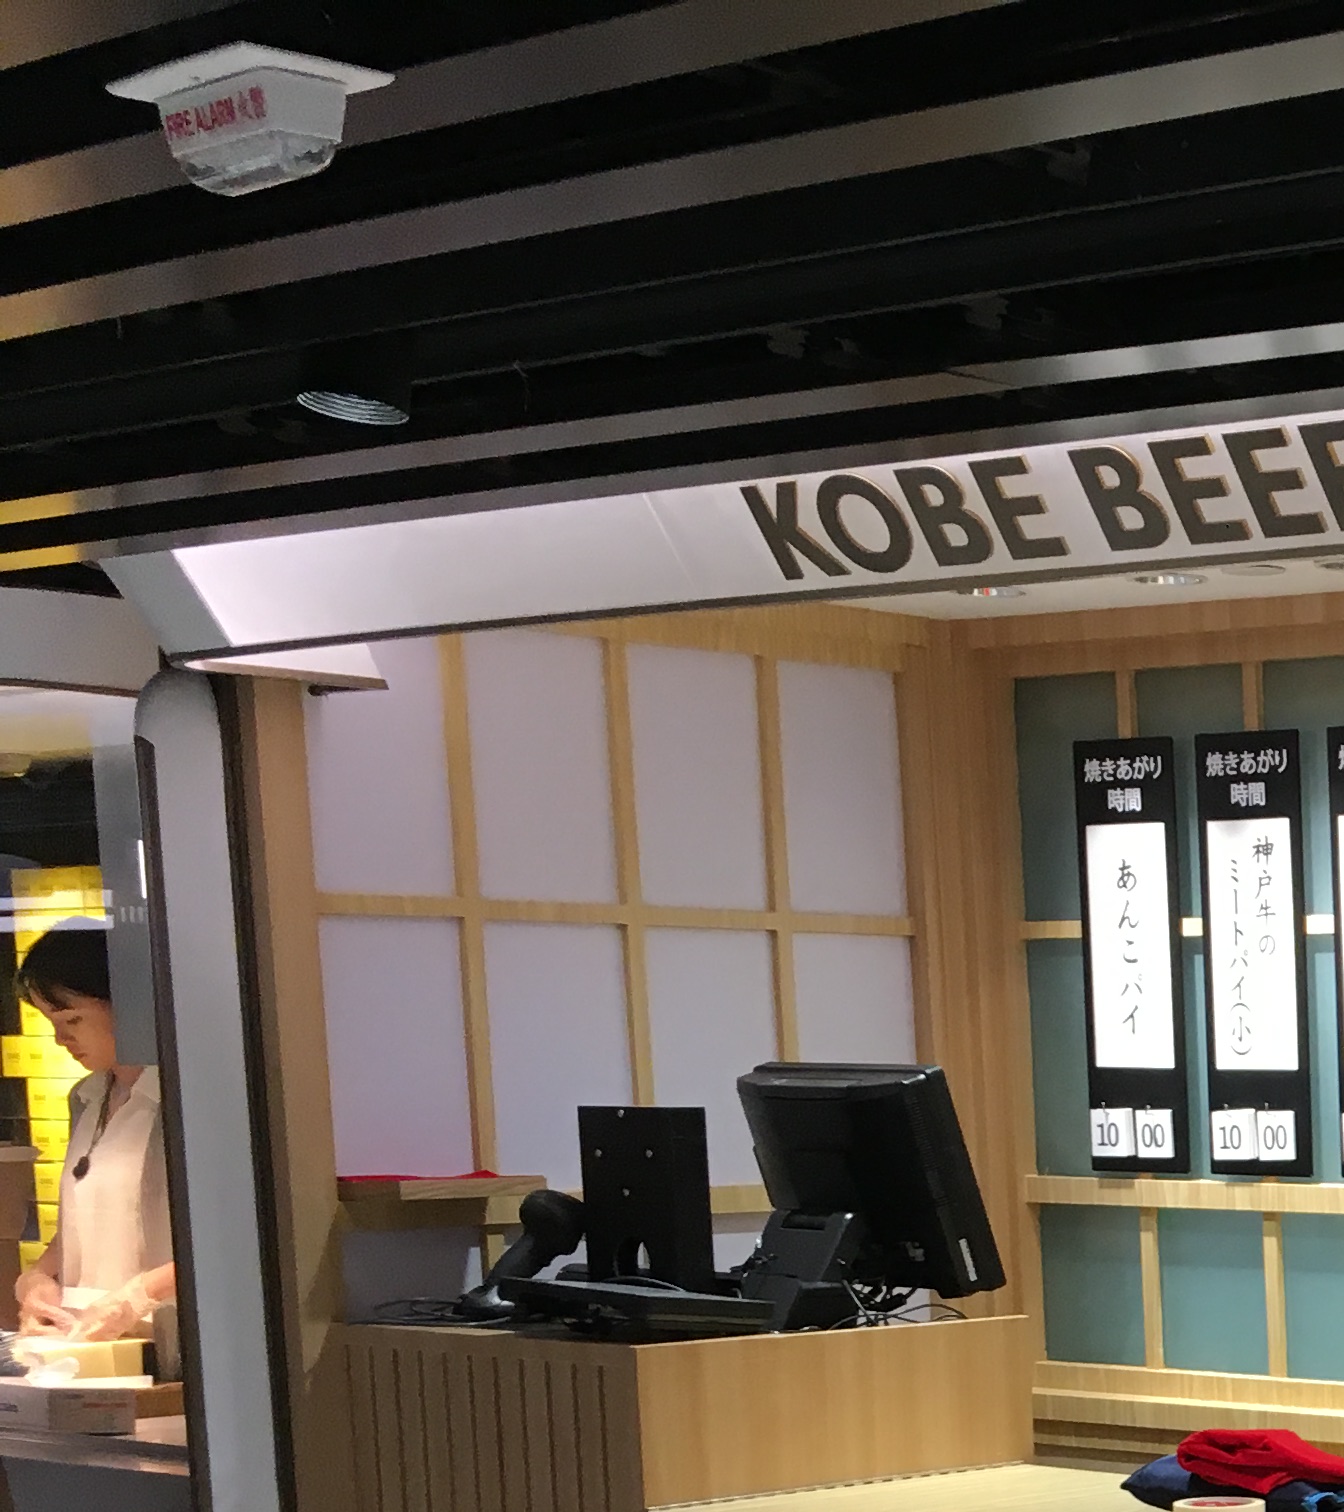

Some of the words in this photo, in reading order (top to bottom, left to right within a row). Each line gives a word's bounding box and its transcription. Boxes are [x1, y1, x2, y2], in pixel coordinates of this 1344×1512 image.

[739, 456, 1071, 580] KOBE
[1084, 755, 1162, 782] 焼きあがり
[1205, 748, 1288, 777] 焼きあがり
[1107, 787, 1142, 813] 時間
[1230, 782, 1265, 806] 時間
[1117, 858, 1143, 1035] あんこパイ
[1097, 1123, 1119, 1148] 10
[1141, 1124, 1165, 1149] 00
[1219, 1125, 1242, 1149] 10
[1263, 1124, 1287, 1149] 00
